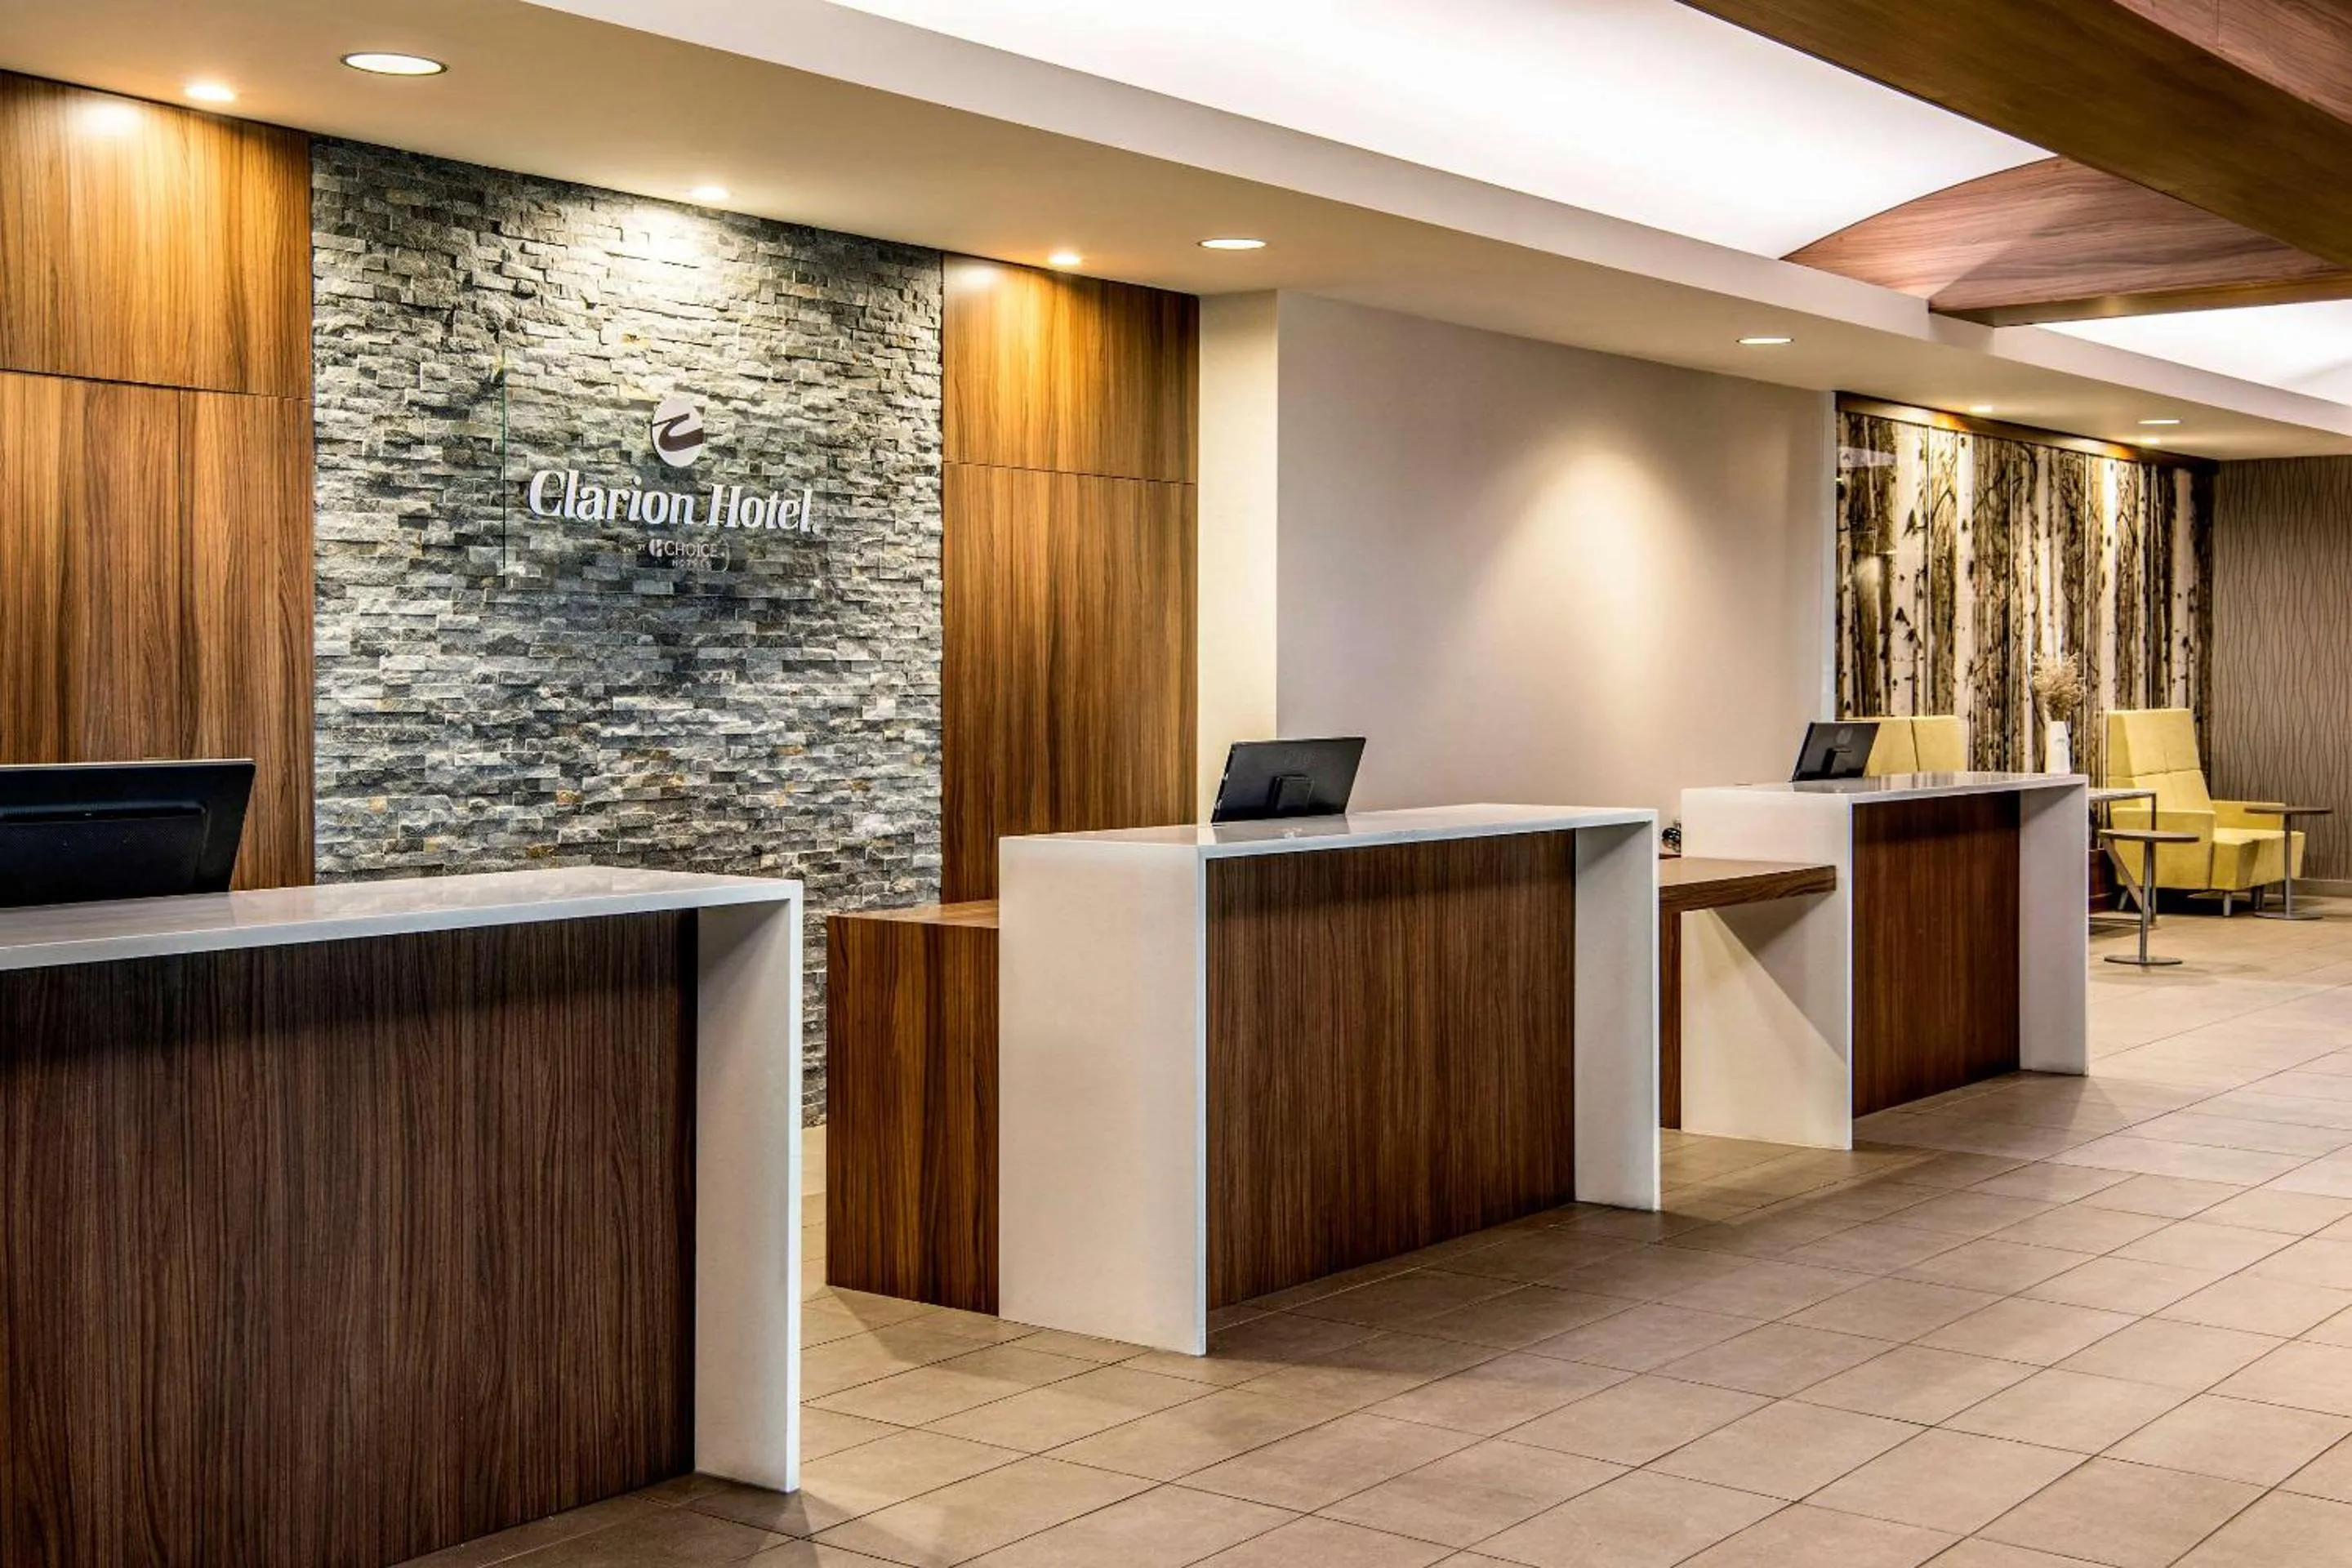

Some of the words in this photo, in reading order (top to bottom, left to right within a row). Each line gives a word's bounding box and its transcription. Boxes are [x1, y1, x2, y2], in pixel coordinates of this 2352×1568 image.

[528, 469, 695, 525] Clarion
[706, 483, 813, 533] Hotel
[663, 540, 718, 558] CHOICE
